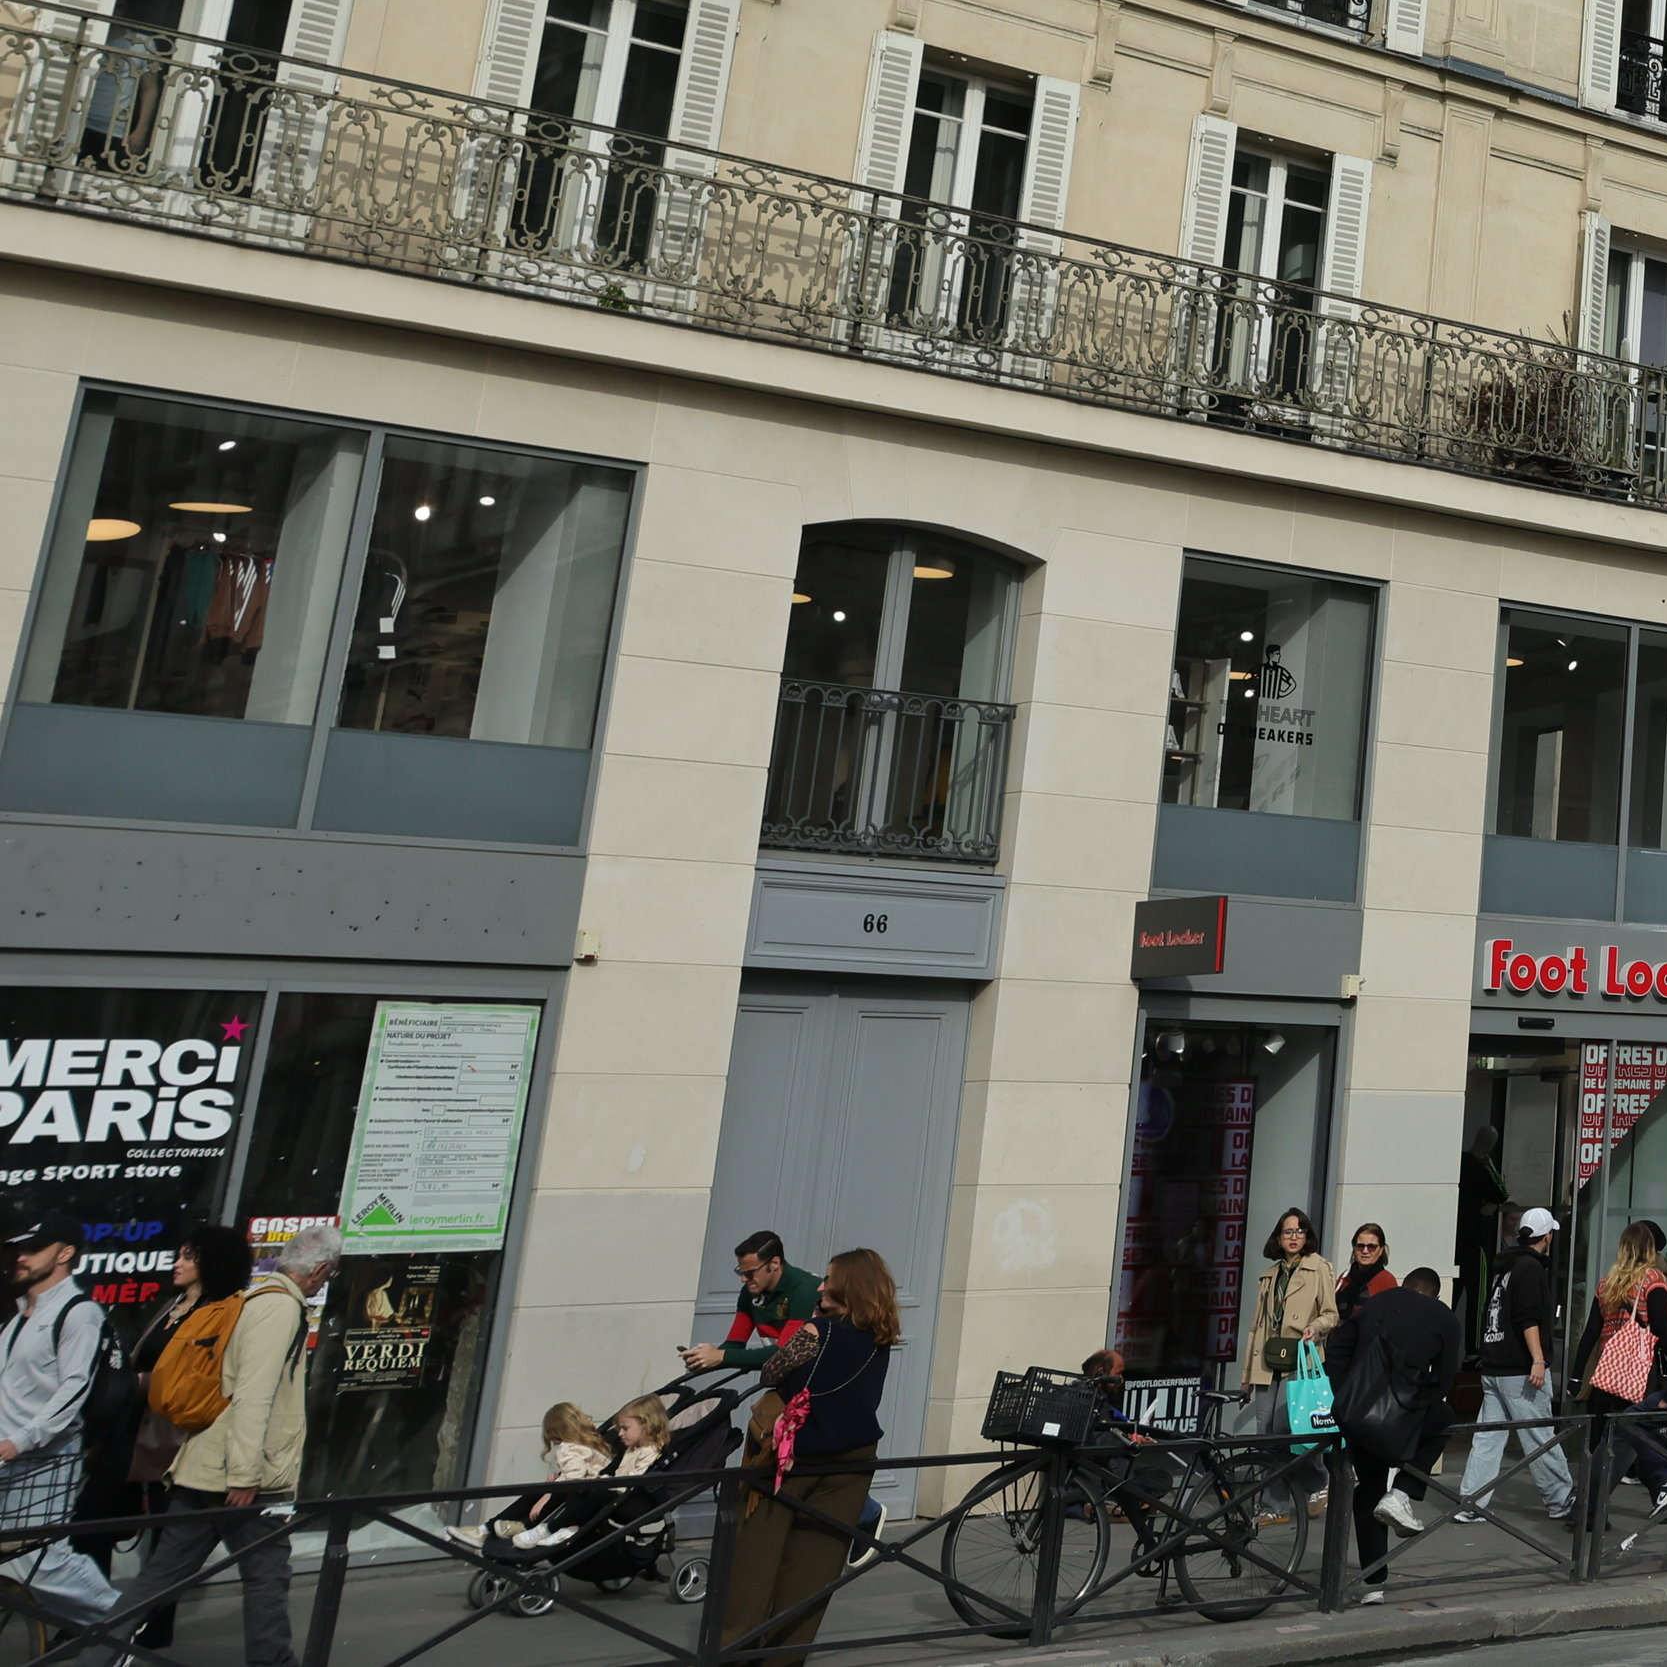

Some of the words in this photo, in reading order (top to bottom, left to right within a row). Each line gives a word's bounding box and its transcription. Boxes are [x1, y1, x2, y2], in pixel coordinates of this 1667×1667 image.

[1257, 728, 1314, 745] EAKERS
[862, 914, 889, 934] 66
[1139, 931, 1164, 948] Foot
[1166, 929, 1205, 947] Locker
[1483, 939, 1588, 995] Foot
[389, 1018, 438, 1027] BÉNÉFICIAIRE
[1584, 1078, 1596, 1089] DE
[1582, 1128, 1593, 1138] DE
[126, 1147, 226, 1158] COLLECTOR2024
[41, 1164, 121, 1181] SPORT
[124, 1163, 182, 1178] store
[351, 1197, 379, 1225] LEROY
[377, 1192, 405, 1224] MERLIN
[410, 1213, 485, 1225] leroymerlin.fr
[345, 1343, 426, 1360] VERDI
[343, 1357, 421, 1372] REQUIEM
